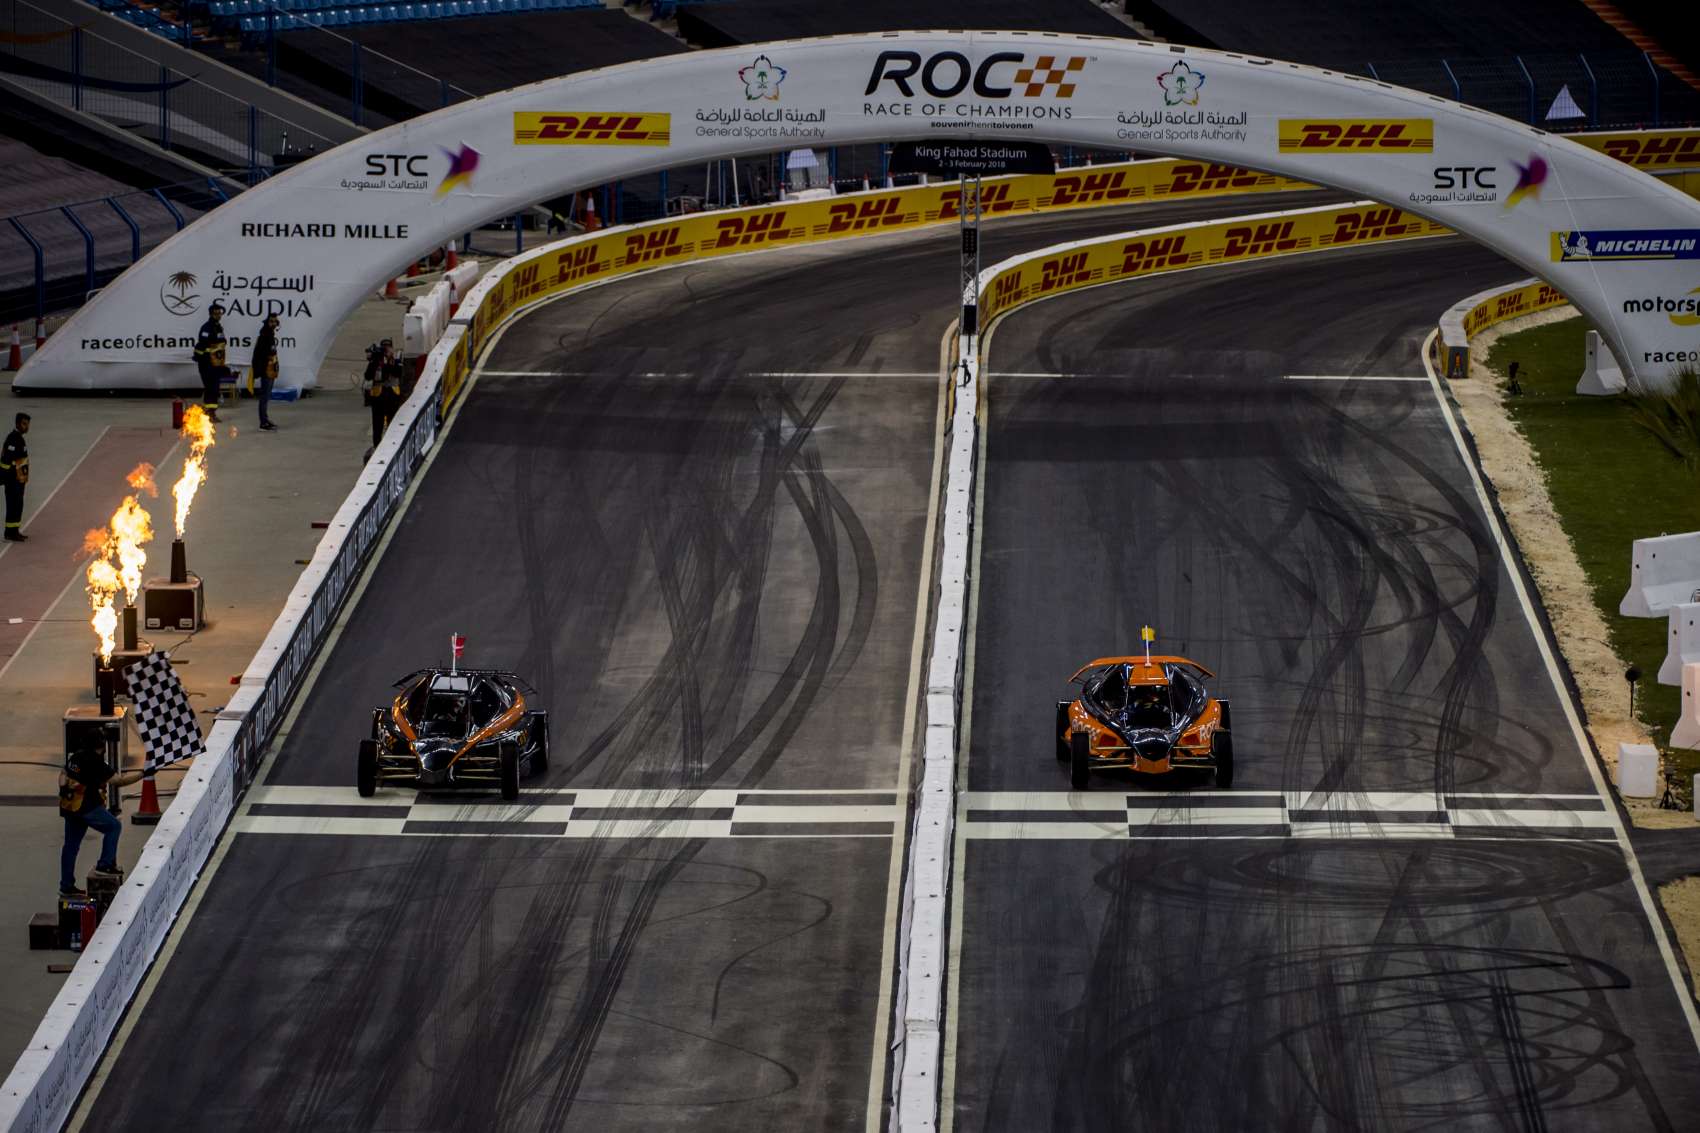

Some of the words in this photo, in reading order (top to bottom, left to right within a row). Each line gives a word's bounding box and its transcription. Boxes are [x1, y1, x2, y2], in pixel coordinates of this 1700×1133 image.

[865, 50, 1025, 98] ROC
[696, 108, 741, 125] للرياضة
[743, 108, 782, 122] العامة
[864, 103, 912, 116] RACE
[922, 104, 946, 116] OF
[956, 104, 1072, 119] CHAMPIONS
[1117, 111, 1162, 127] للرياضة
[1165, 111, 1204, 124] العامة
[538, 116, 649, 139] DHL
[696, 126, 742, 137] General
[743, 126, 777, 139] Sports
[780, 126, 825, 139] Authority
[930, 120, 1033, 129] souvenirhenritoivonen
[1117, 128, 1164, 139] General
[1165, 129, 1199, 141] Sports
[1200, 129, 1246, 142] Authority
[1301, 124, 1412, 147] DHL
[915, 146, 941, 160] King
[943, 146, 978, 158] Fahad
[980, 146, 1028, 159] Stadium
[1604, 137, 1700, 164] DHL
[366, 154, 428, 177] STC
[938, 160, 944, 168] 2
[948, 160, 954, 168] 3
[955, 160, 987, 170] February
[987, 160, 1006, 169] 2018
[1052, 172, 1130, 205] DHL
[1170, 164, 1258, 192] DHL
[1433, 167, 1497, 189] STC
[829, 198, 905, 233] DHL
[1333, 209, 1407, 243] DHL
[242, 223, 336, 238] RICHARD
[344, 224, 409, 239] MILLE
[716, 211, 791, 248] DHL
[1224, 221, 1297, 257] DHL
[625, 227, 682, 265] DHL
[1122, 236, 1189, 273] DHL
[1595, 238, 1697, 252] MICHELIN
[557, 245, 600, 283] DHL
[1041, 253, 1091, 291] DHL
[212, 270, 314, 296] السعودية
[513, 264, 541, 301] DHL
[1496, 293, 1524, 317] DHL
[1538, 286, 1564, 305] DH
[1623, 296, 1700, 316] motors
